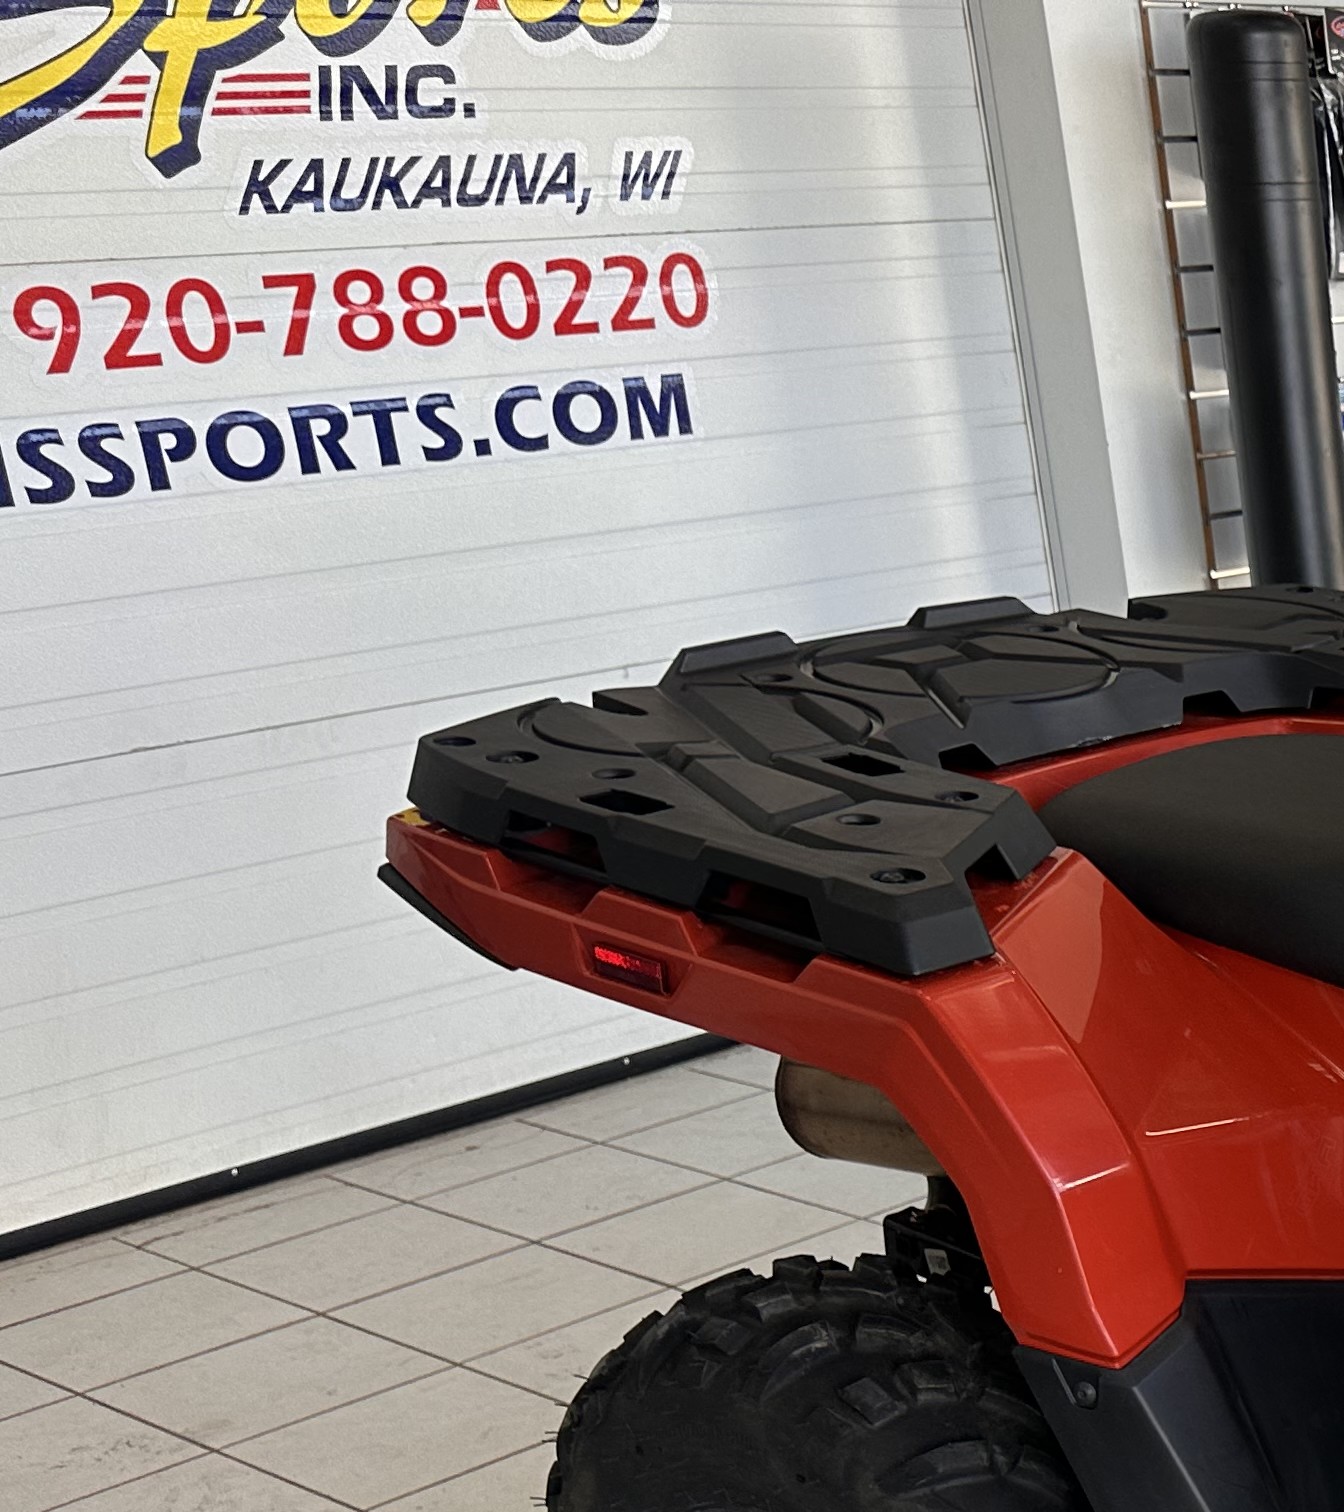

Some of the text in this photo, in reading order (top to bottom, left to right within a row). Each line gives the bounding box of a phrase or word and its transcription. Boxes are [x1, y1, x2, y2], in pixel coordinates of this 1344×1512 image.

[318, 65, 477, 121] INC.
[238, 149, 681, 216] KAUKAUNA, WI
[12, 252, 710, 375] 920-788-0220
[0, 373, 693, 507] SSPORTS.COM
